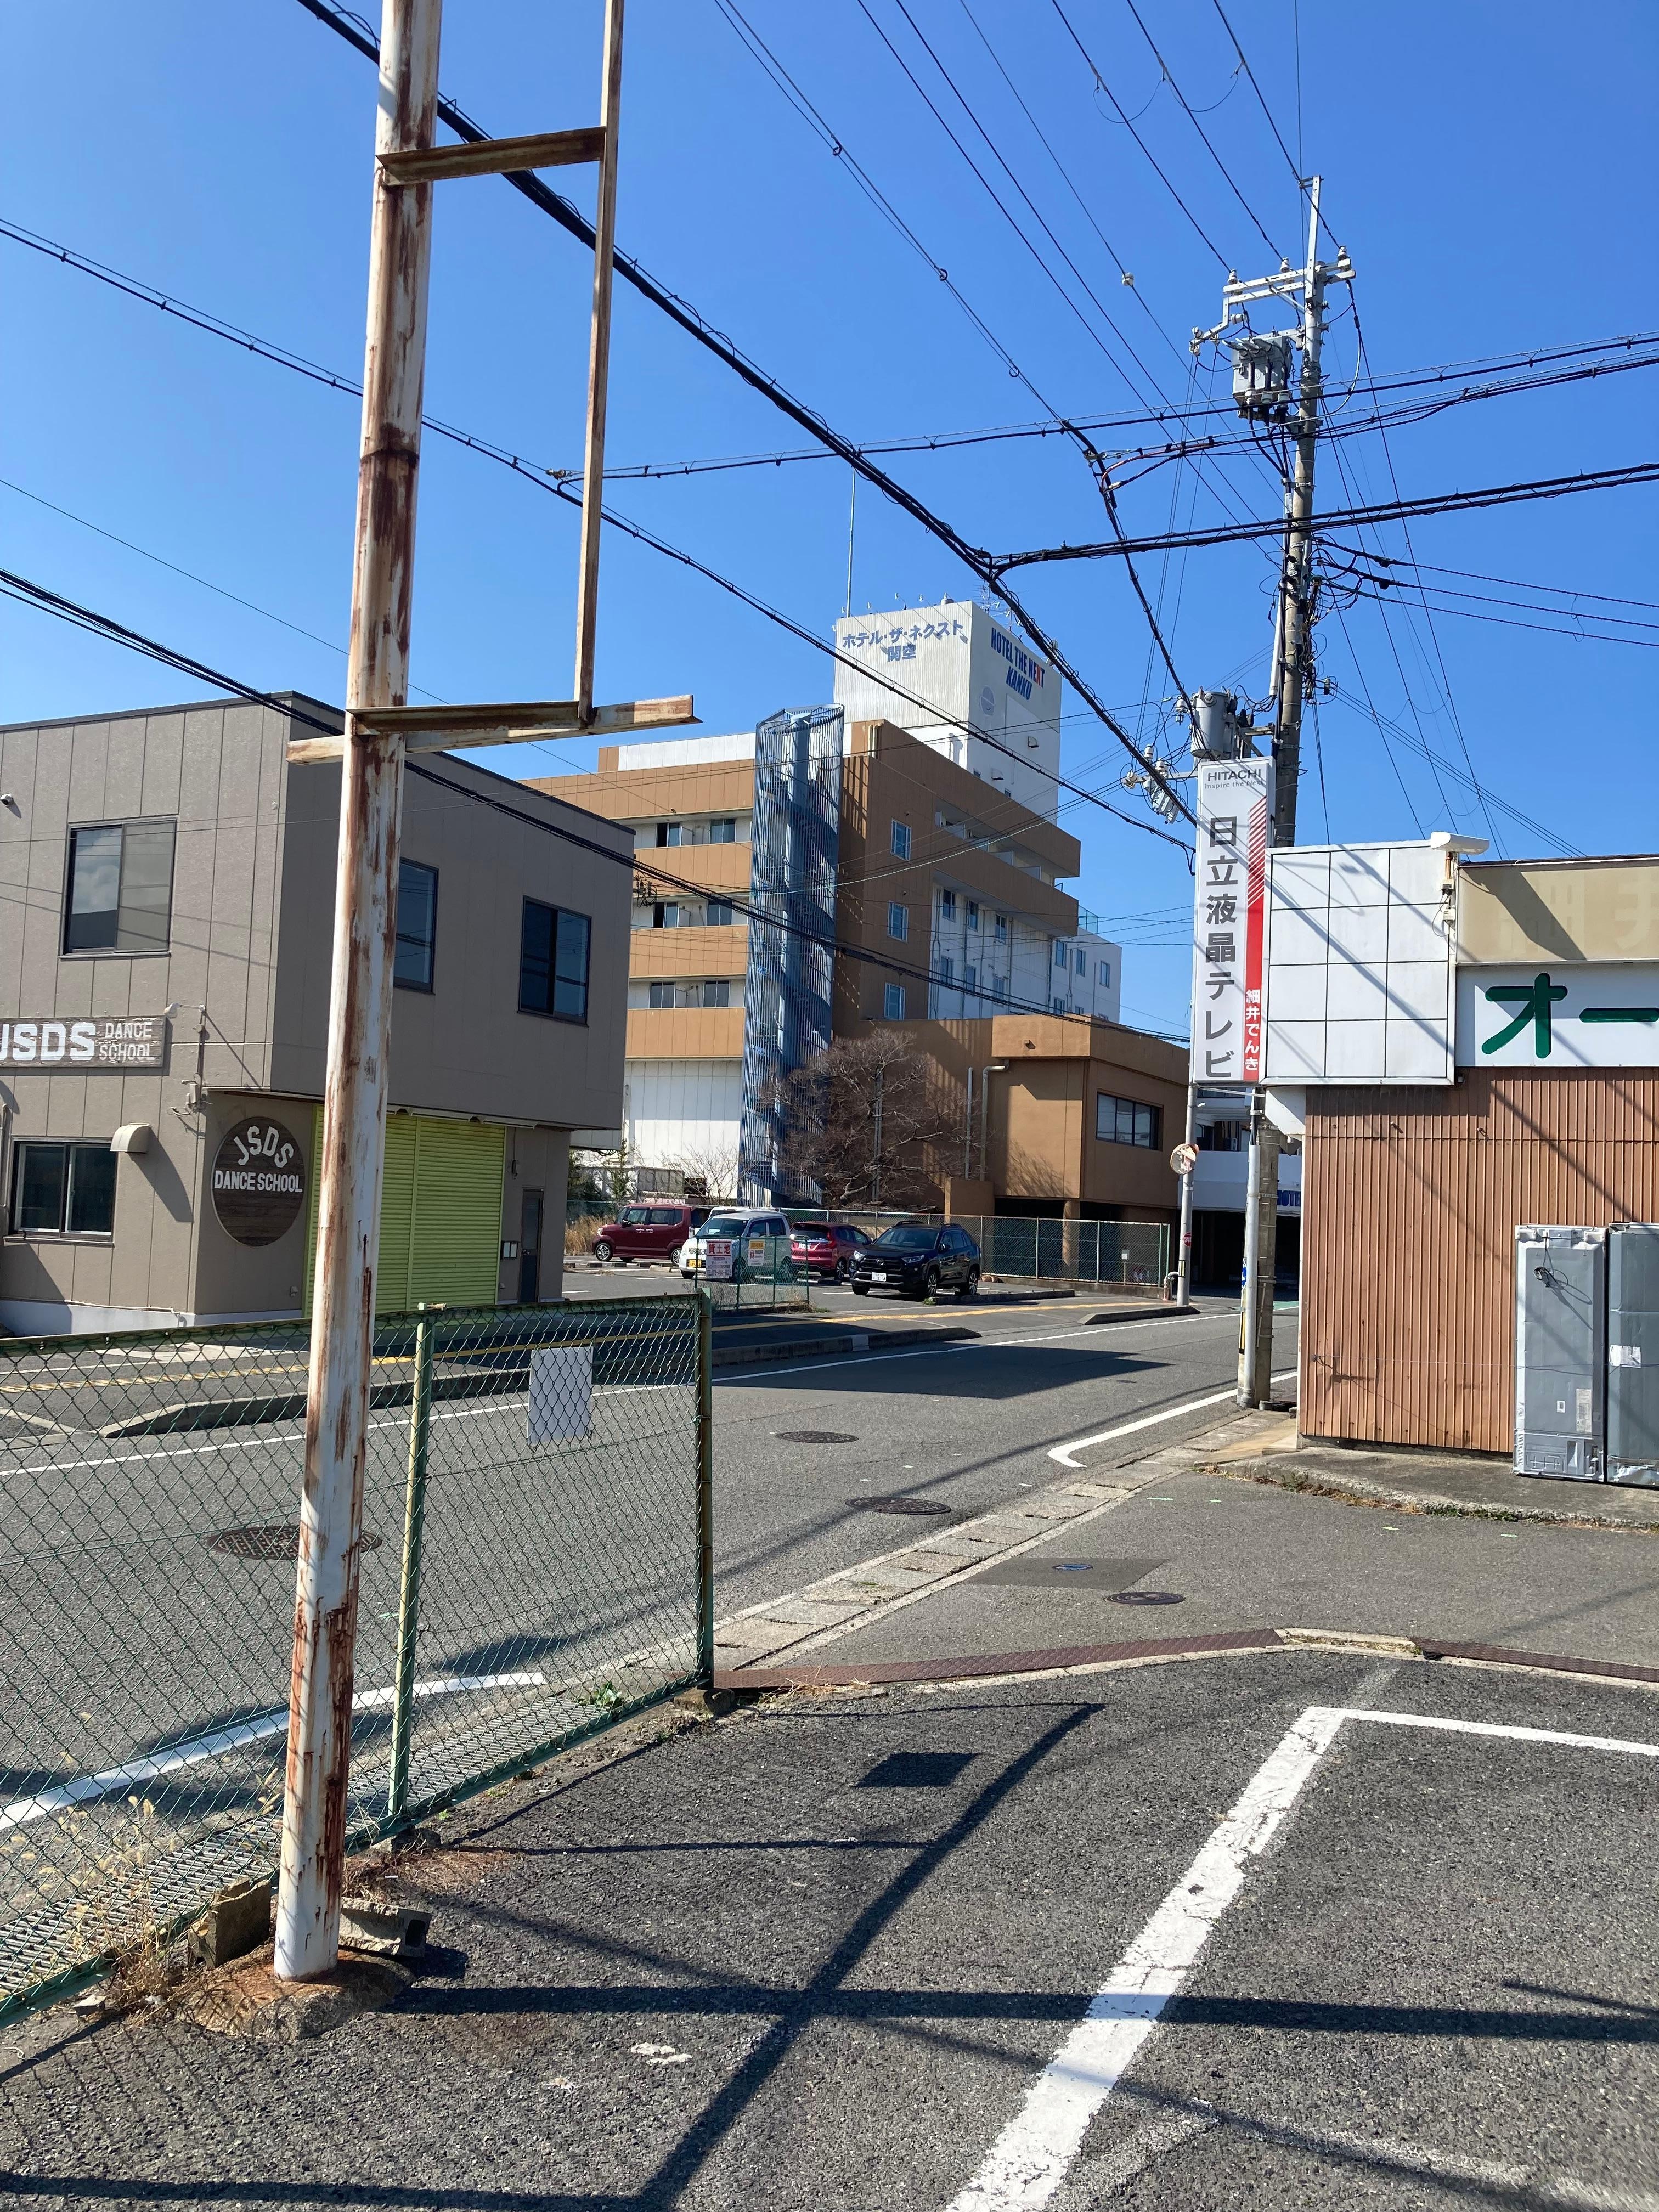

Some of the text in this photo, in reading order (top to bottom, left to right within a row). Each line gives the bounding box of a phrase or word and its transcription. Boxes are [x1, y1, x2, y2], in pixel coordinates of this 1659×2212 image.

[843, 619, 963, 649] ホテル・ザ・ネクスト
[887, 644, 916, 662] 関空
[991, 627, 1045, 689] HOTEL THE NEXT
[1006, 665, 1032, 700] KANKU
[1207, 769, 1261, 781] HITACHI
[1205, 816, 1238, 1077] 日立液晶テレビ
[105, 1022, 153, 1039] DANCE
[1245, 989, 1261, 1071] 細井でんき
[99, 1043, 156, 1061] SCHOOL
[234, 1126, 294, 1168] JSDS
[215, 1170, 303, 1193] DANCE SCHOOL
